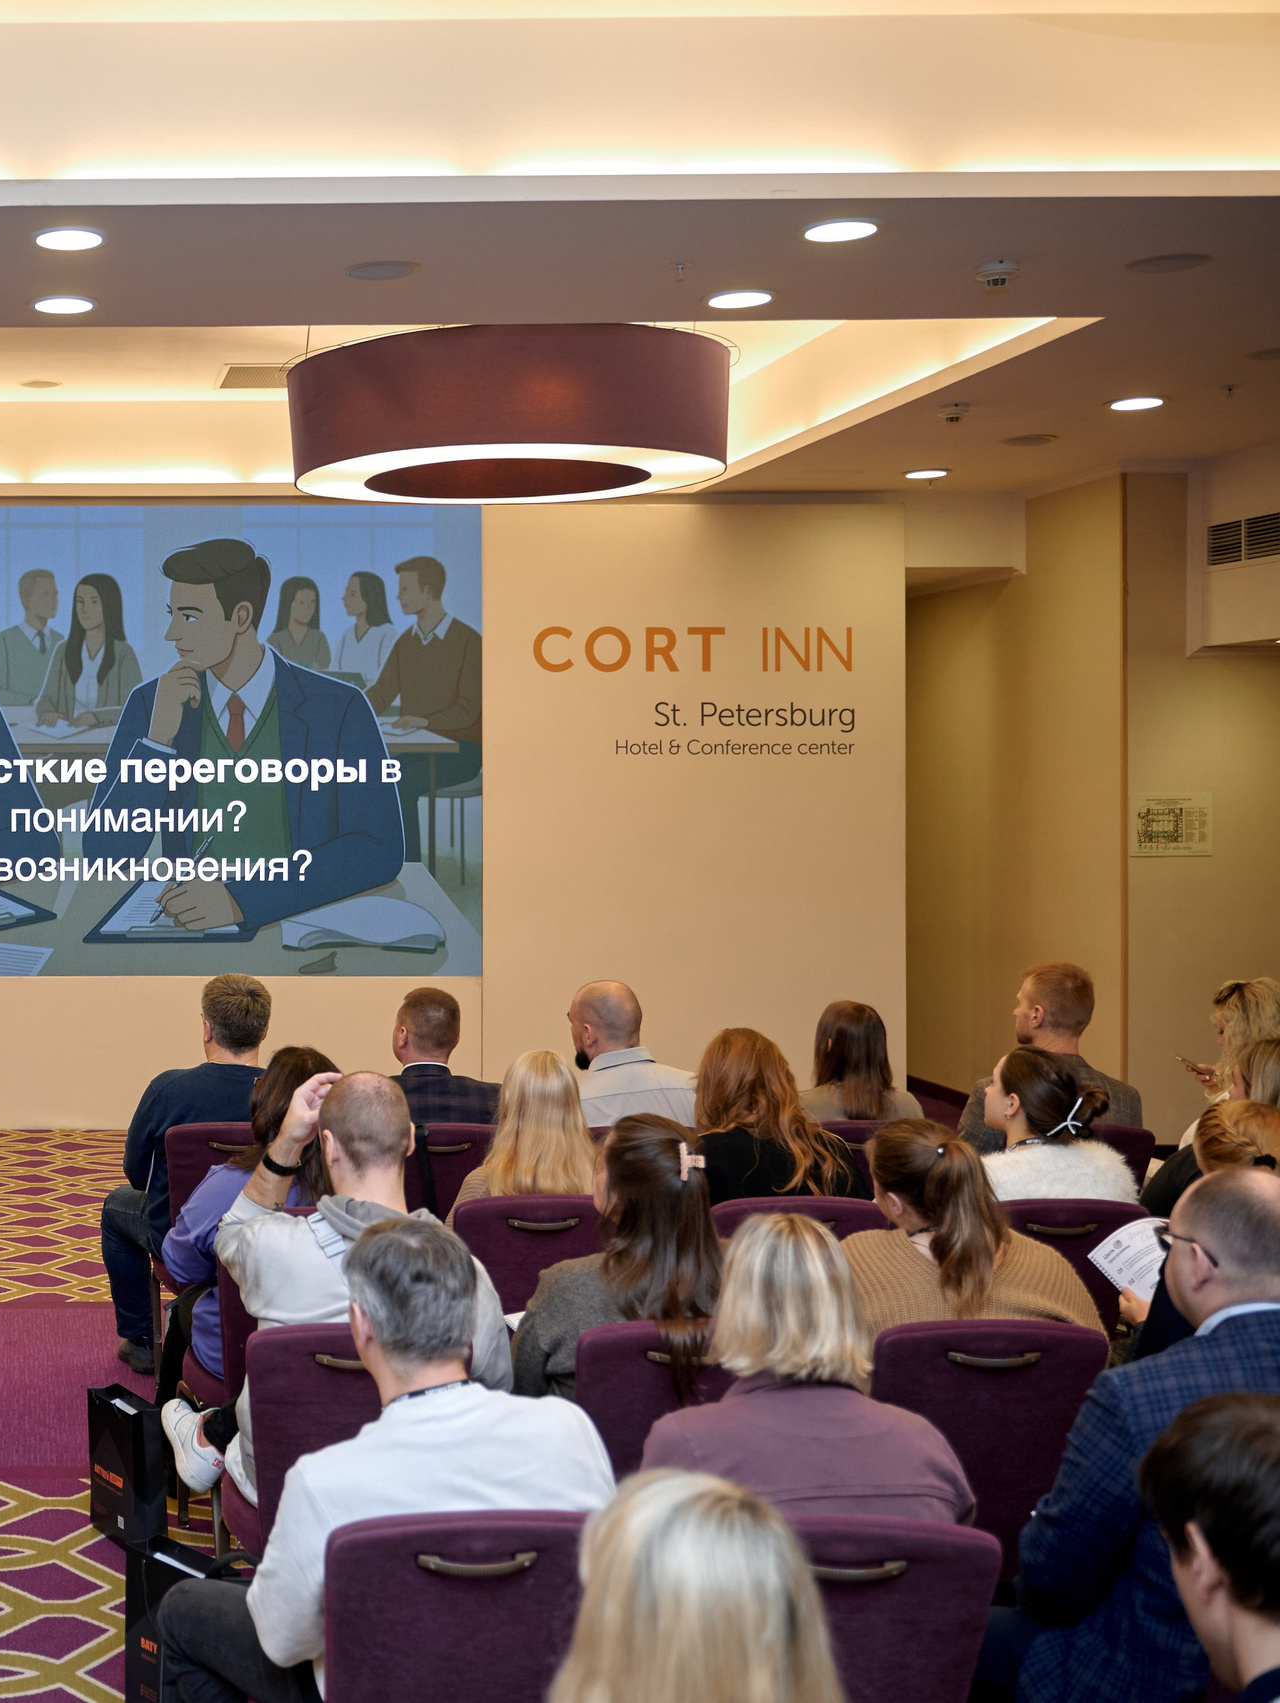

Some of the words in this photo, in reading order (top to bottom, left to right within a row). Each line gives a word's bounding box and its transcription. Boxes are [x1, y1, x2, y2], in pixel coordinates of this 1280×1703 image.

[532, 626, 726, 673] CORT
[761, 626, 854, 673] INN
[654, 702, 687, 727] St.
[700, 702, 855, 733] Petersburg
[615, 739, 664, 756] Hotel
[668, 739, 681, 756] &
[686, 739, 792, 756] Conference
[797, 740, 855, 756] center
[120, 758, 367, 792] переговоры
[381, 759, 402, 783] в
[11, 800, 247, 833] понимании?
